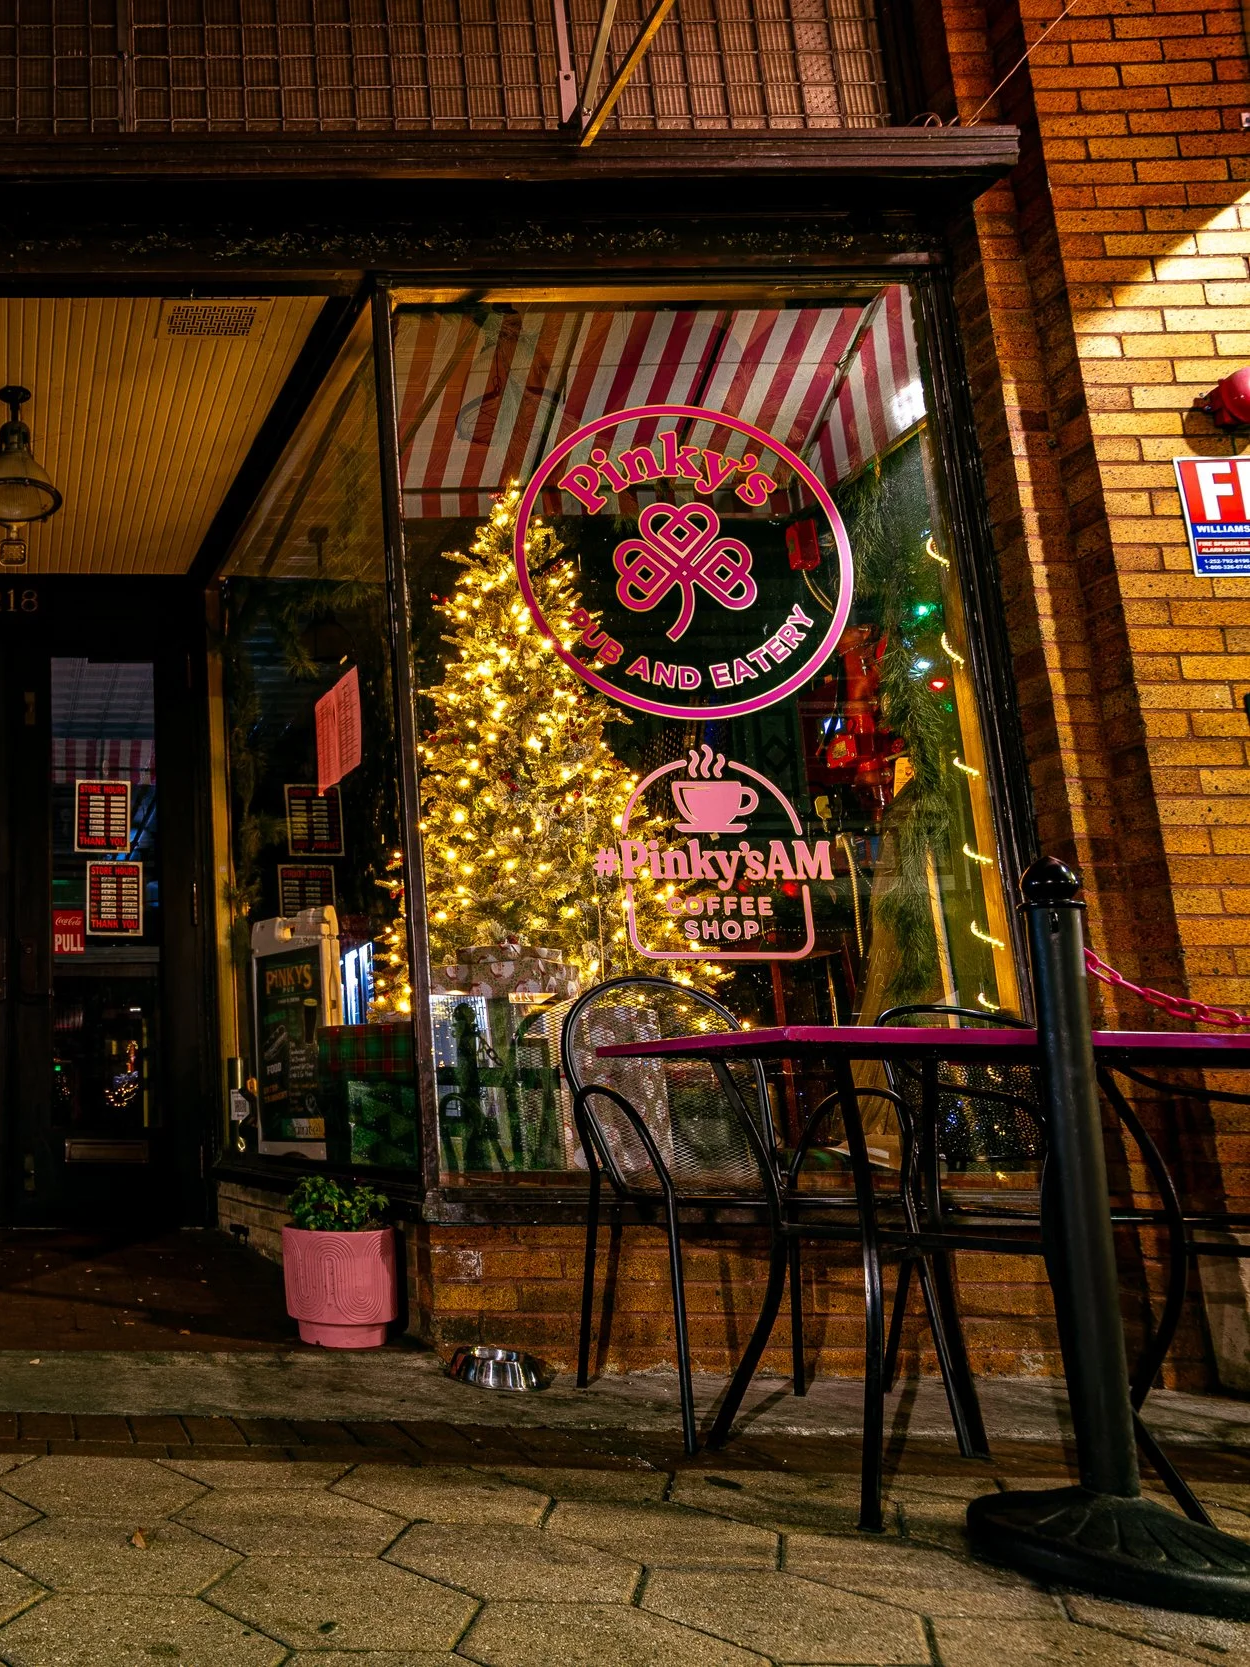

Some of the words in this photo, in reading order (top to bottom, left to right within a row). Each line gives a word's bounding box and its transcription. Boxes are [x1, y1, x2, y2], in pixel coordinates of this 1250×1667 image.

[557, 431, 778, 516] Pinky's
[1196, 524, 1250, 534] WILLIAMS
[567, 607, 625, 665] PUB
[624, 655, 702, 690] AND
[708, 603, 815, 690] EATERY
[79, 784, 102, 794] STORE
[103, 784, 127, 794] HOURS
[79, 836, 107, 846] THANK
[110, 837, 126, 846] YOU
[91, 866, 113, 875] STORE
[115, 866, 138, 875] HOURS
[592, 838, 835, 892] #Pinky'sAM
[665, 896, 774, 916] COFFEE
[91, 919, 119, 929] THANK
[122, 919, 138, 929] YOU
[684, 919, 760, 940] SHOP
[54, 933, 85, 952] PULL
